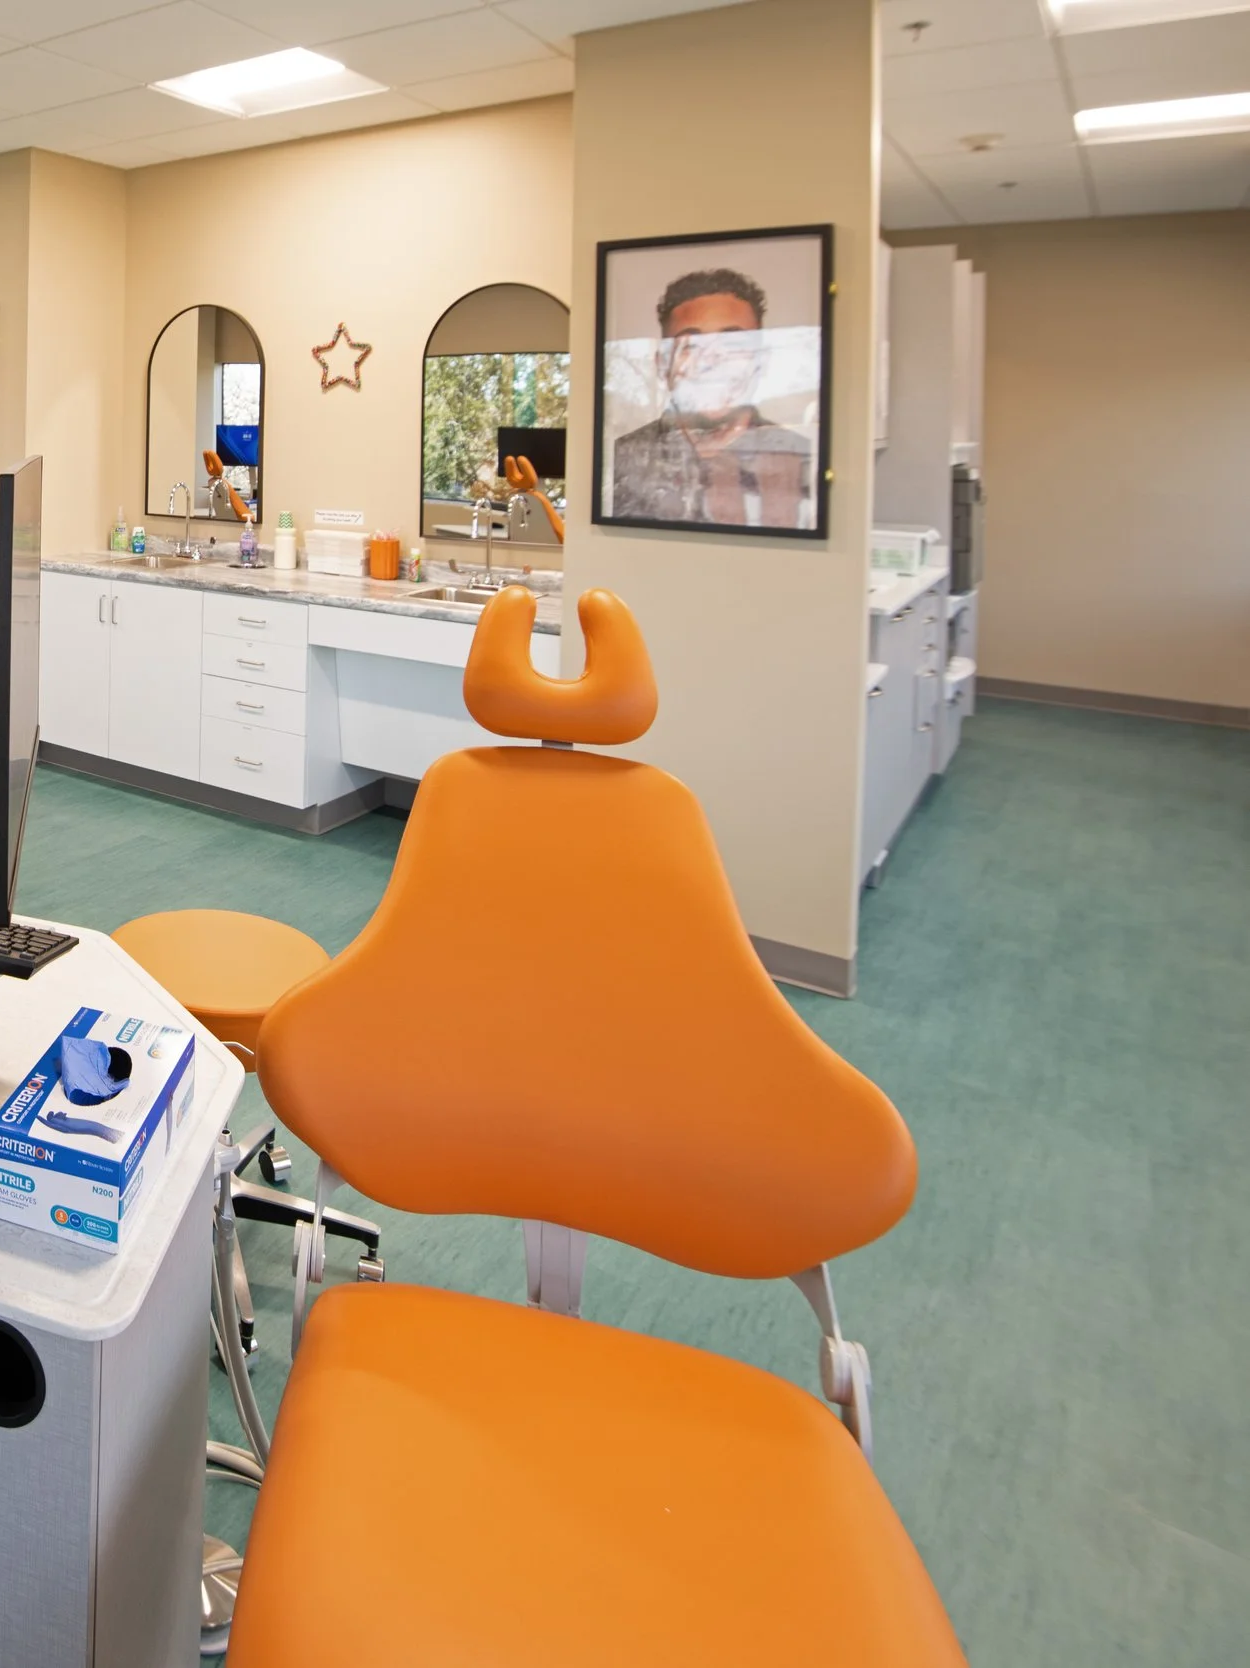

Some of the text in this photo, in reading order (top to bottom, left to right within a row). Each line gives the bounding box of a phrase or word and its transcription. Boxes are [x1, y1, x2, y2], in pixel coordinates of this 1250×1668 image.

[119, 1018, 142, 1041] NITRILE
[1, 1072, 48, 1123] CRITERION
[10, 1191, 37, 1205] GLOVES
[92, 1186, 114, 1198] N200
